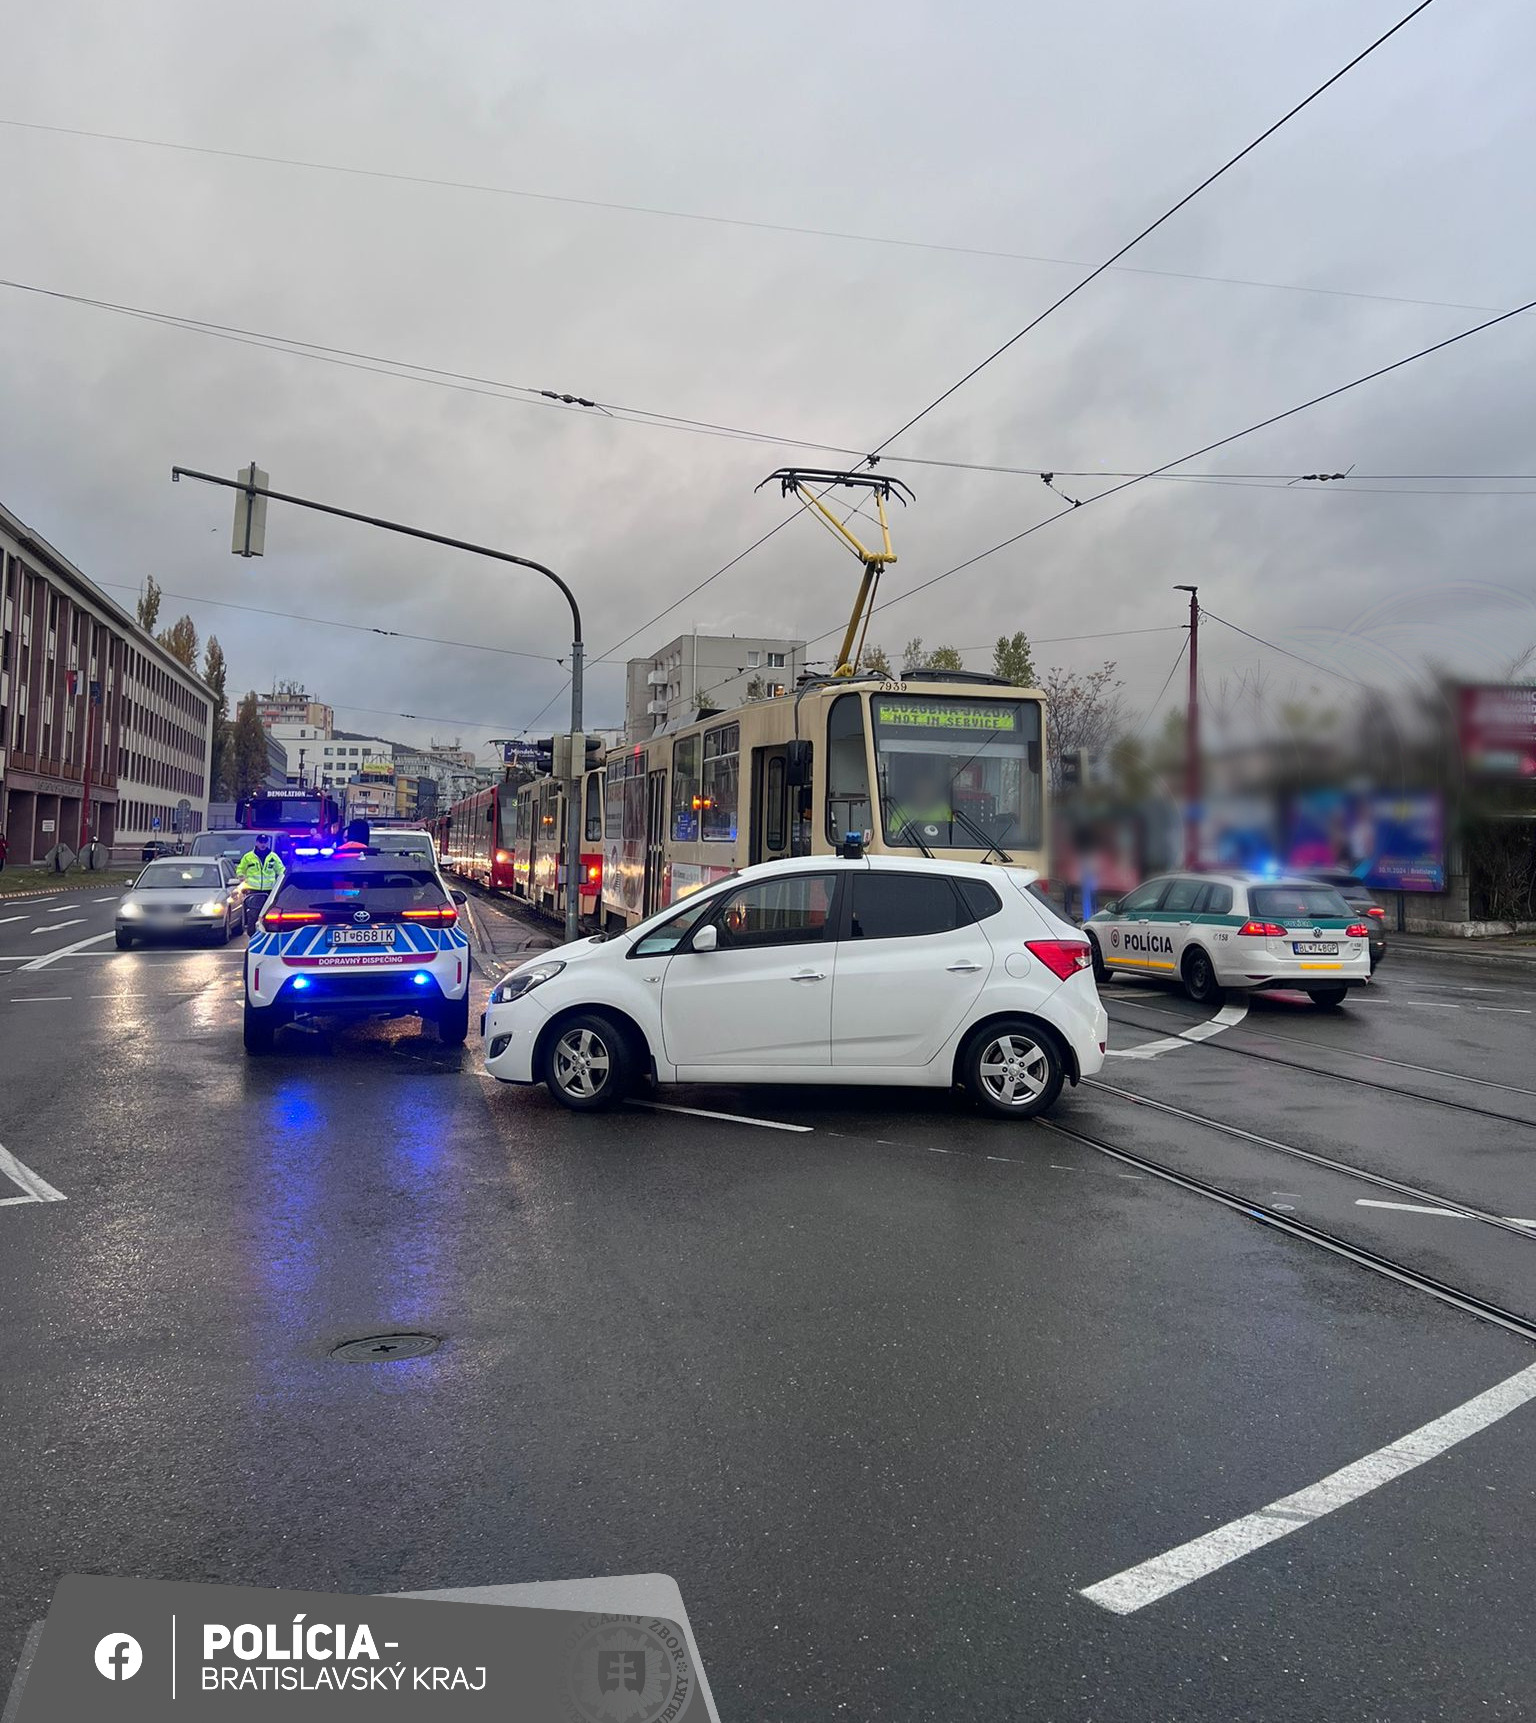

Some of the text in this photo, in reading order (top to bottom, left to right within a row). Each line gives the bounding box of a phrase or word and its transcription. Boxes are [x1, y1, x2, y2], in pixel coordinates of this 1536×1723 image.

[880, 682, 907, 691] 7939
[893, 714, 1000, 728] NOT IN SERVICE
[267, 790, 306, 798] DEMOLATION
[1218, 933, 1229, 942] 158
[1124, 932, 1174, 954] POLÍCIA
[318, 956, 404, 966] DOPRAVNÝ DISPEČING
